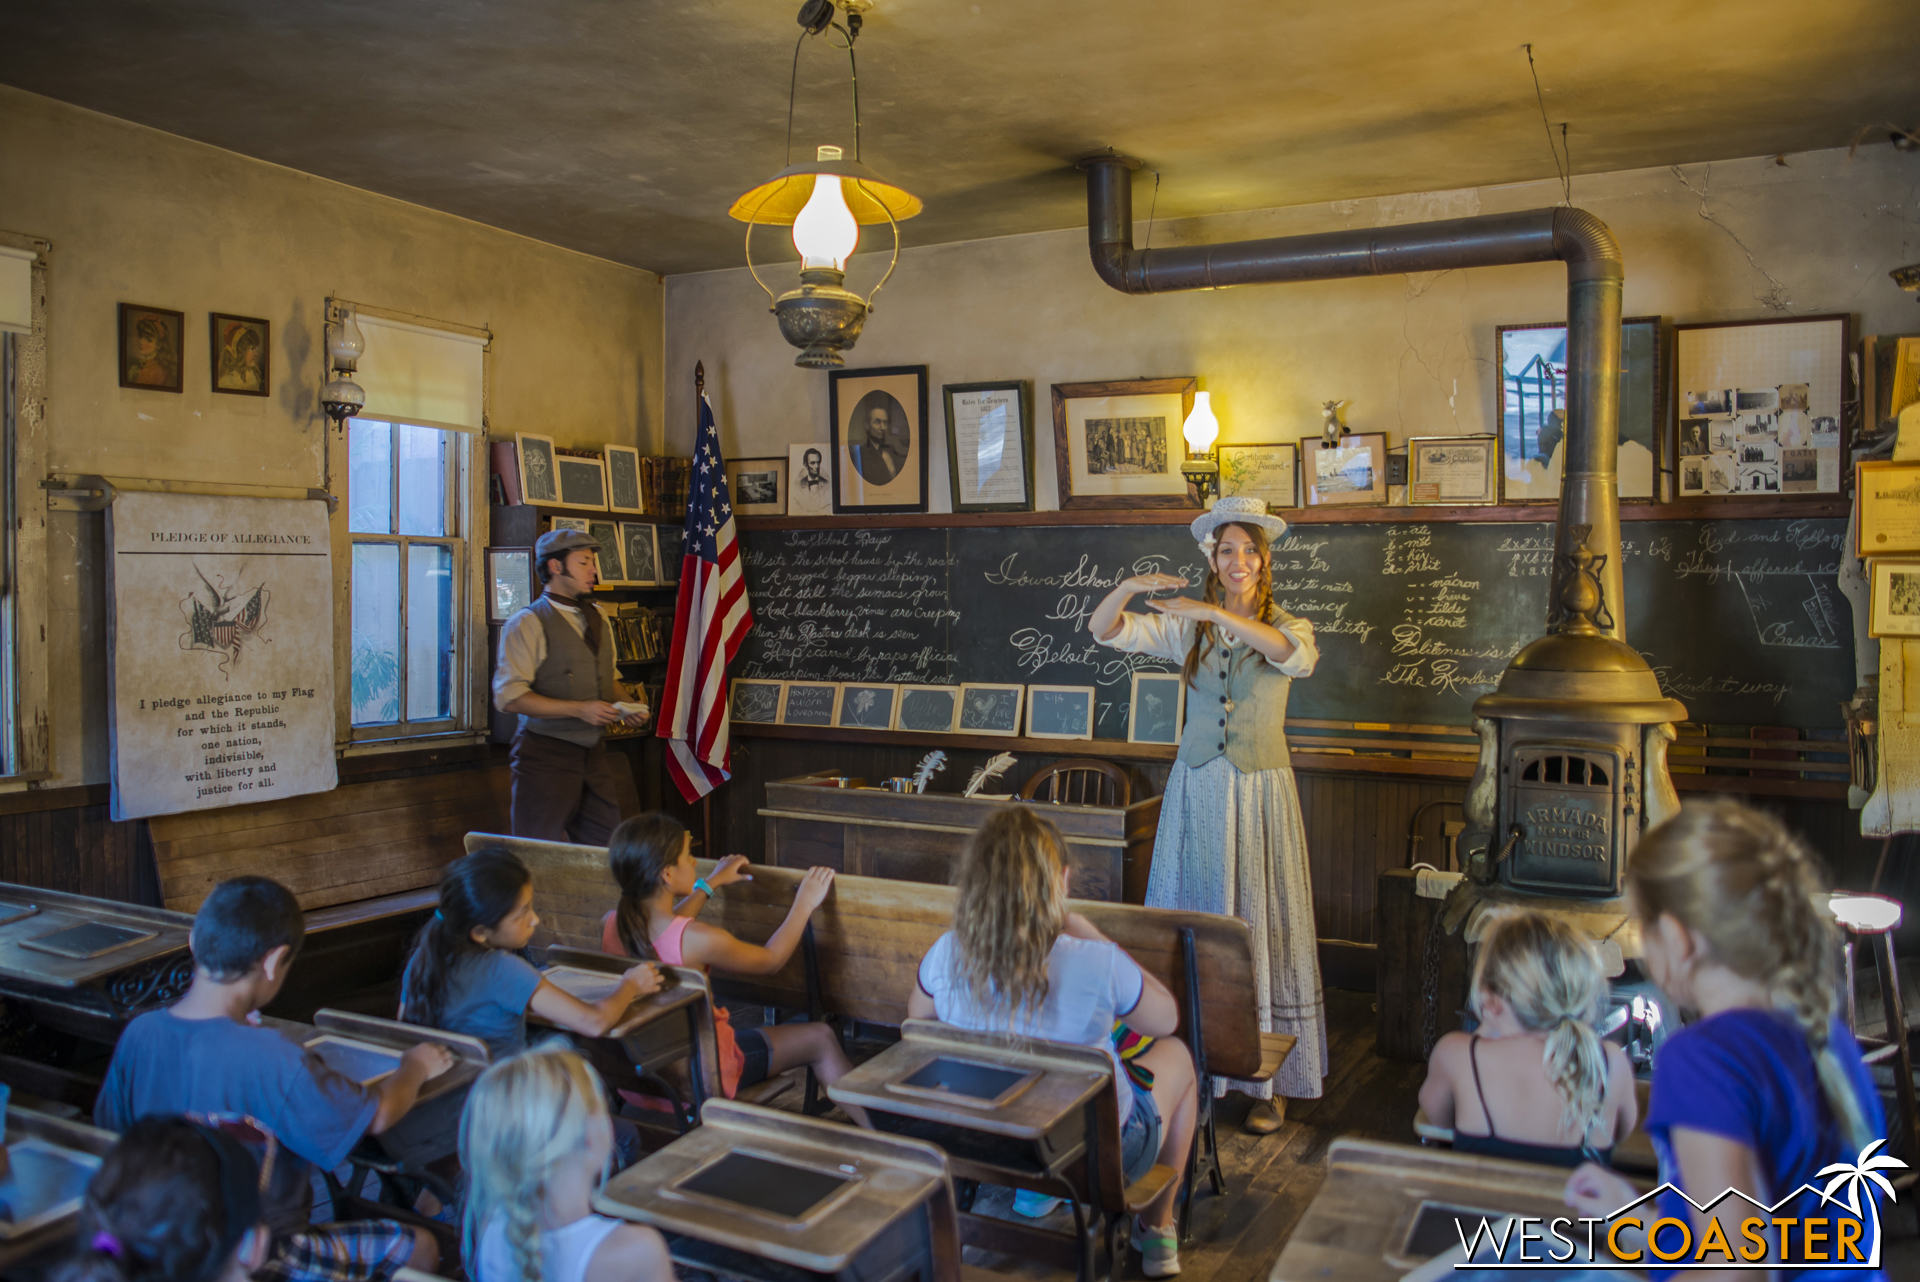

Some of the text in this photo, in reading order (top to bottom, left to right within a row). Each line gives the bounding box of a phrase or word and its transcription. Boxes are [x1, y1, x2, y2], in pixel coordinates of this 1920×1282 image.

[1235, 452, 1275, 464] Certificate
[1257, 461, 1283, 470] Award
[151, 532, 311, 545] PLEDGE OF ALLEGIANCE
[1744, 531, 1780, 542] and
[792, 552, 813, 567] the
[762, 568, 781, 585] A
[1058, 553, 1124, 589] School
[777, 585, 791, 598] it
[795, 584, 826, 599] still
[831, 584, 853, 598] the
[757, 603, 790, 620] And
[891, 608, 913, 618] are
[778, 625, 796, 640] the
[845, 620, 870, 638] desk
[874, 628, 886, 639] is
[1377, 658, 1428, 687] The
[1651, 666, 1790, 705] Kindest way
[139, 687, 315, 711] I pledge allegiance to my Flag
[185, 704, 279, 721] and the Republic
[177, 718, 286, 738] for which it stands,
[201, 735, 261, 750] one nation,
[204, 750, 264, 766] indivisible,
[185, 763, 276, 782] with liberty and
[196, 778, 274, 799] justice for all.
[1525, 807, 1607, 834] ARMADA
[1524, 840, 1606, 862] WINDSOR
